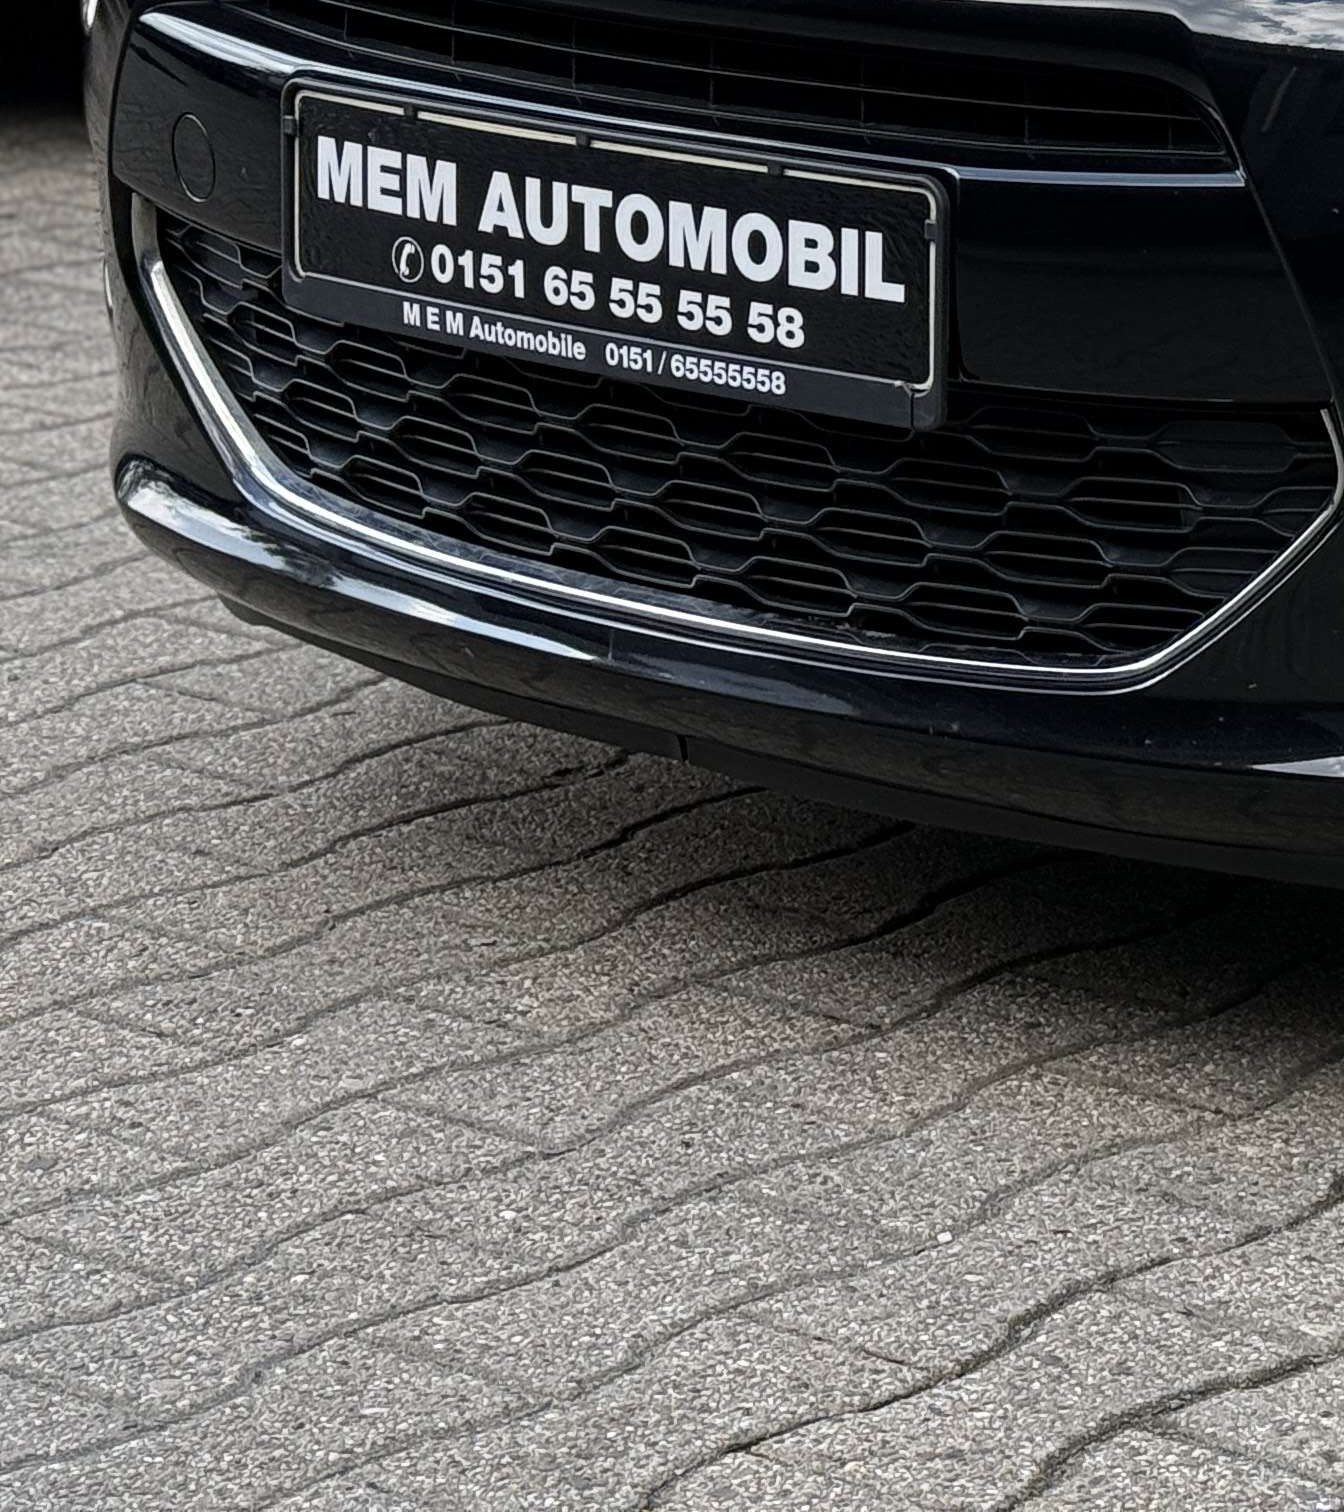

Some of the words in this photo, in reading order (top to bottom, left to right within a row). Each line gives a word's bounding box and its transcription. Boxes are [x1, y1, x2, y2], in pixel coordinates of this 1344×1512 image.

[317, 135, 457, 227] MEM
[477, 170, 906, 303] AUTOMOBIL
[430, 243, 525, 299] 0151
[543, 265, 596, 311] 65
[608, 277, 663, 324] 55
[676, 289, 733, 336] 55
[746, 301, 805, 349] 58
[468, 315, 587, 361] Automobile
